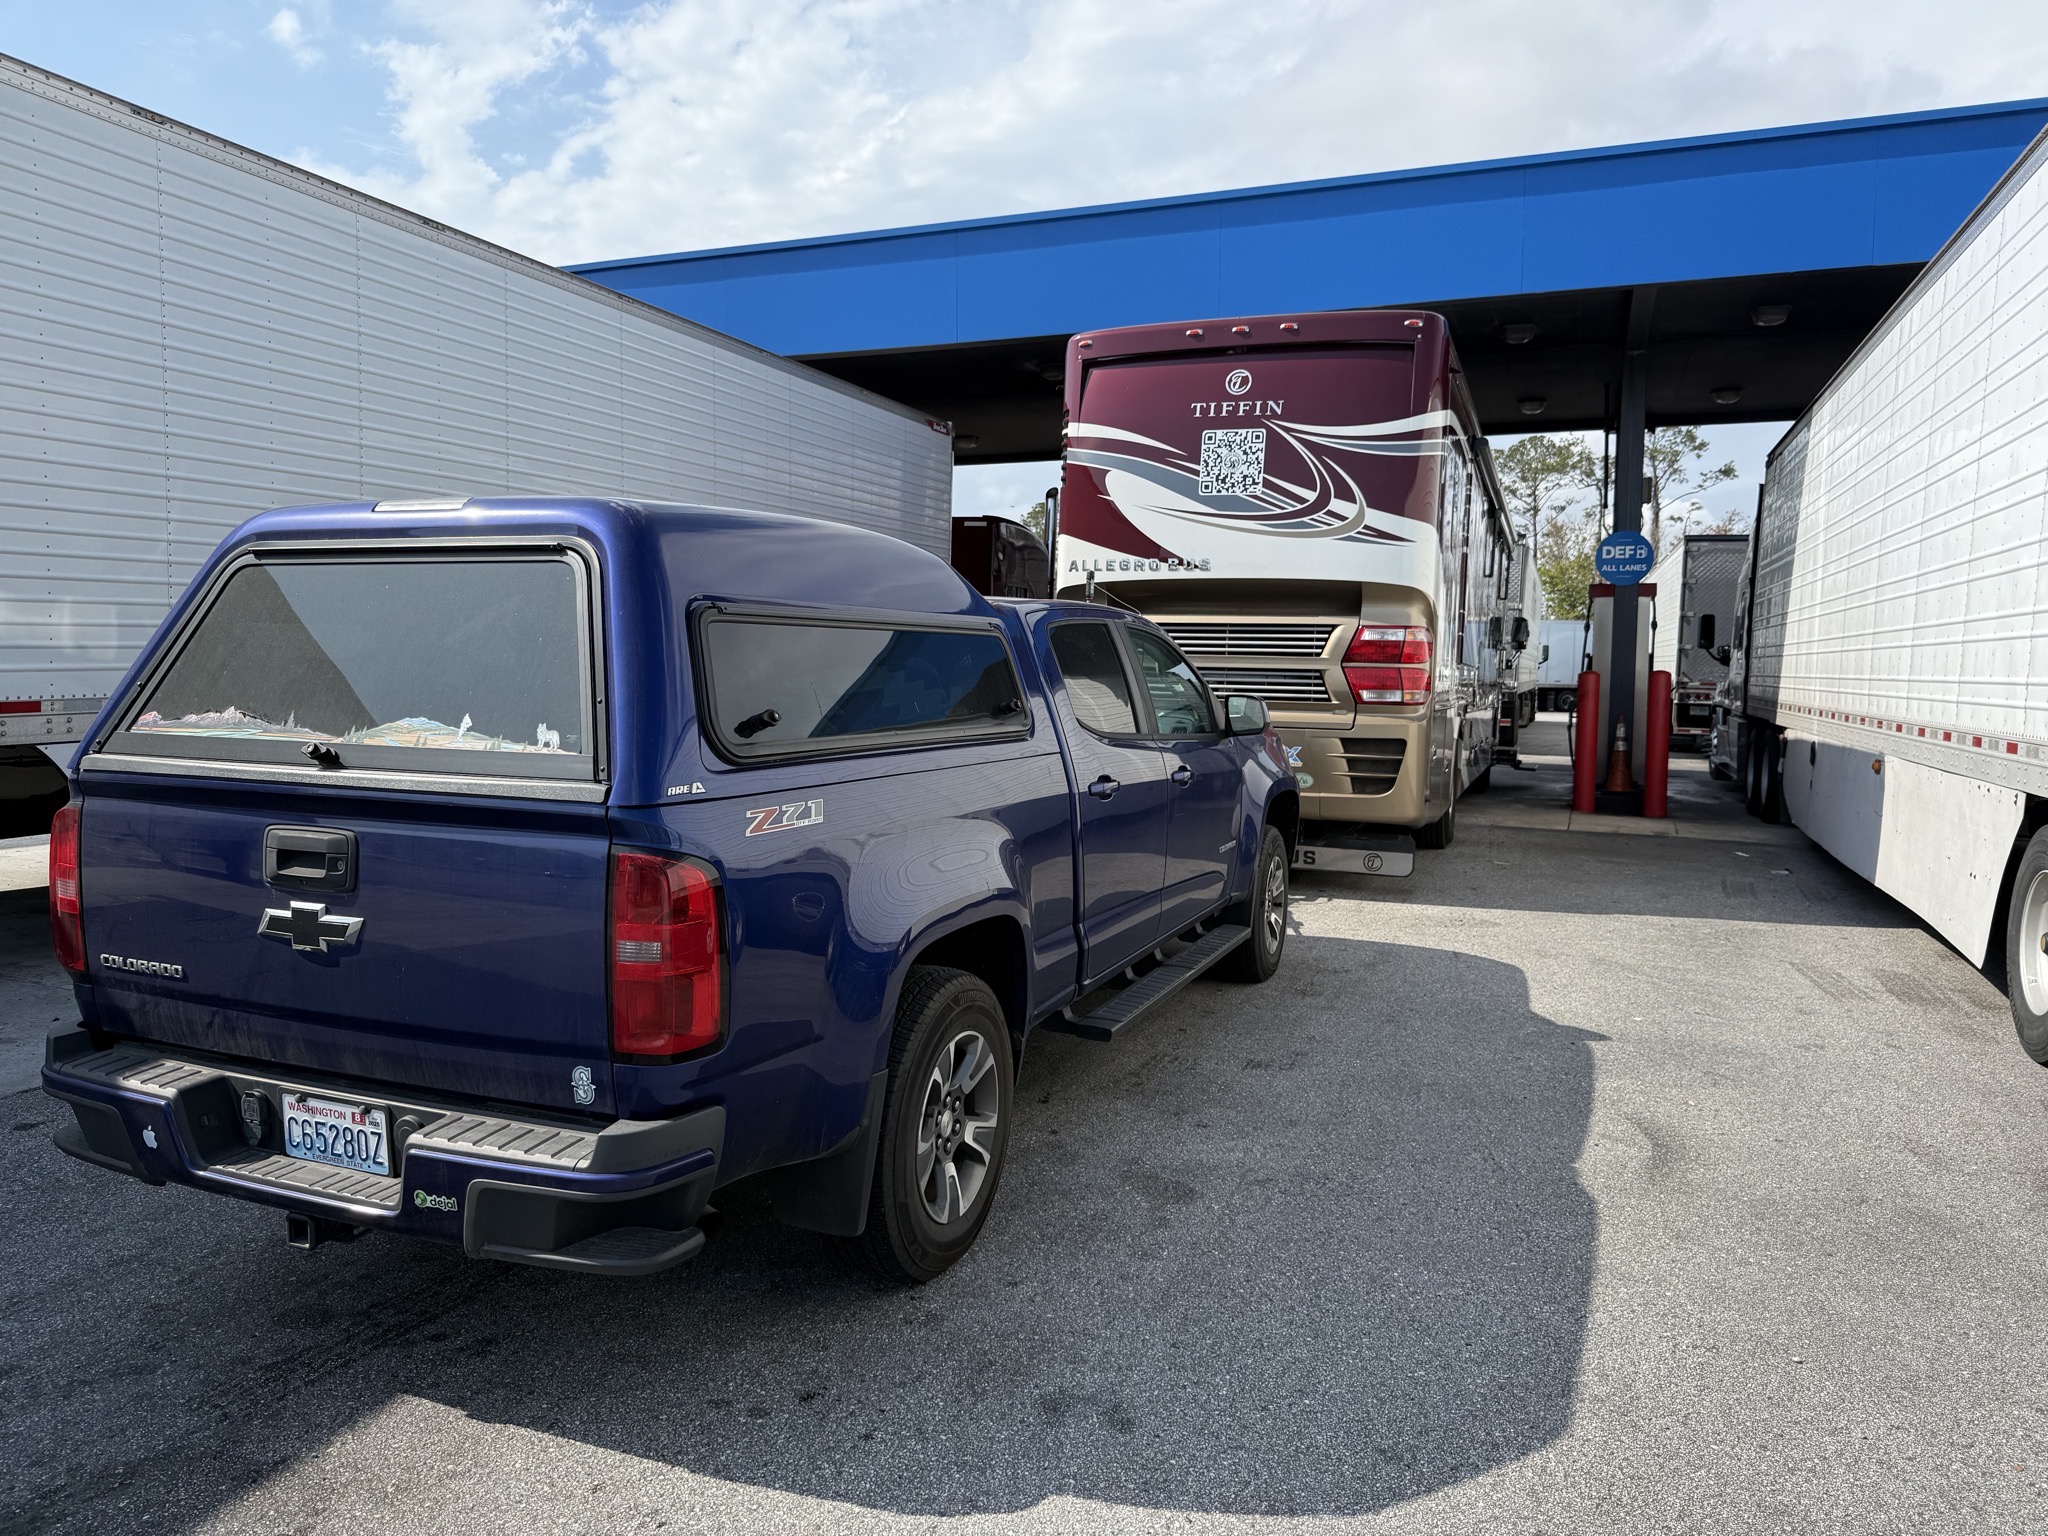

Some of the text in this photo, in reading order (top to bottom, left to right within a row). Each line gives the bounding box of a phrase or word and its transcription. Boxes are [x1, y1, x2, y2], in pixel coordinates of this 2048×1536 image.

[1191, 400, 1284, 417] TIFFIN
[1602, 546, 1635, 558] DEF
[1068, 558, 1211, 572] ALLEGRO BUS
[746, 799, 824, 837] Z71
[100, 953, 183, 978] COLORADO
[288, 1102, 346, 1120] WASHINGTON
[287, 1116, 384, 1165] C65280Z
[312, 1153, 364, 1169] EVERGREEN STATE
[430, 1197, 456, 1210] dejal
